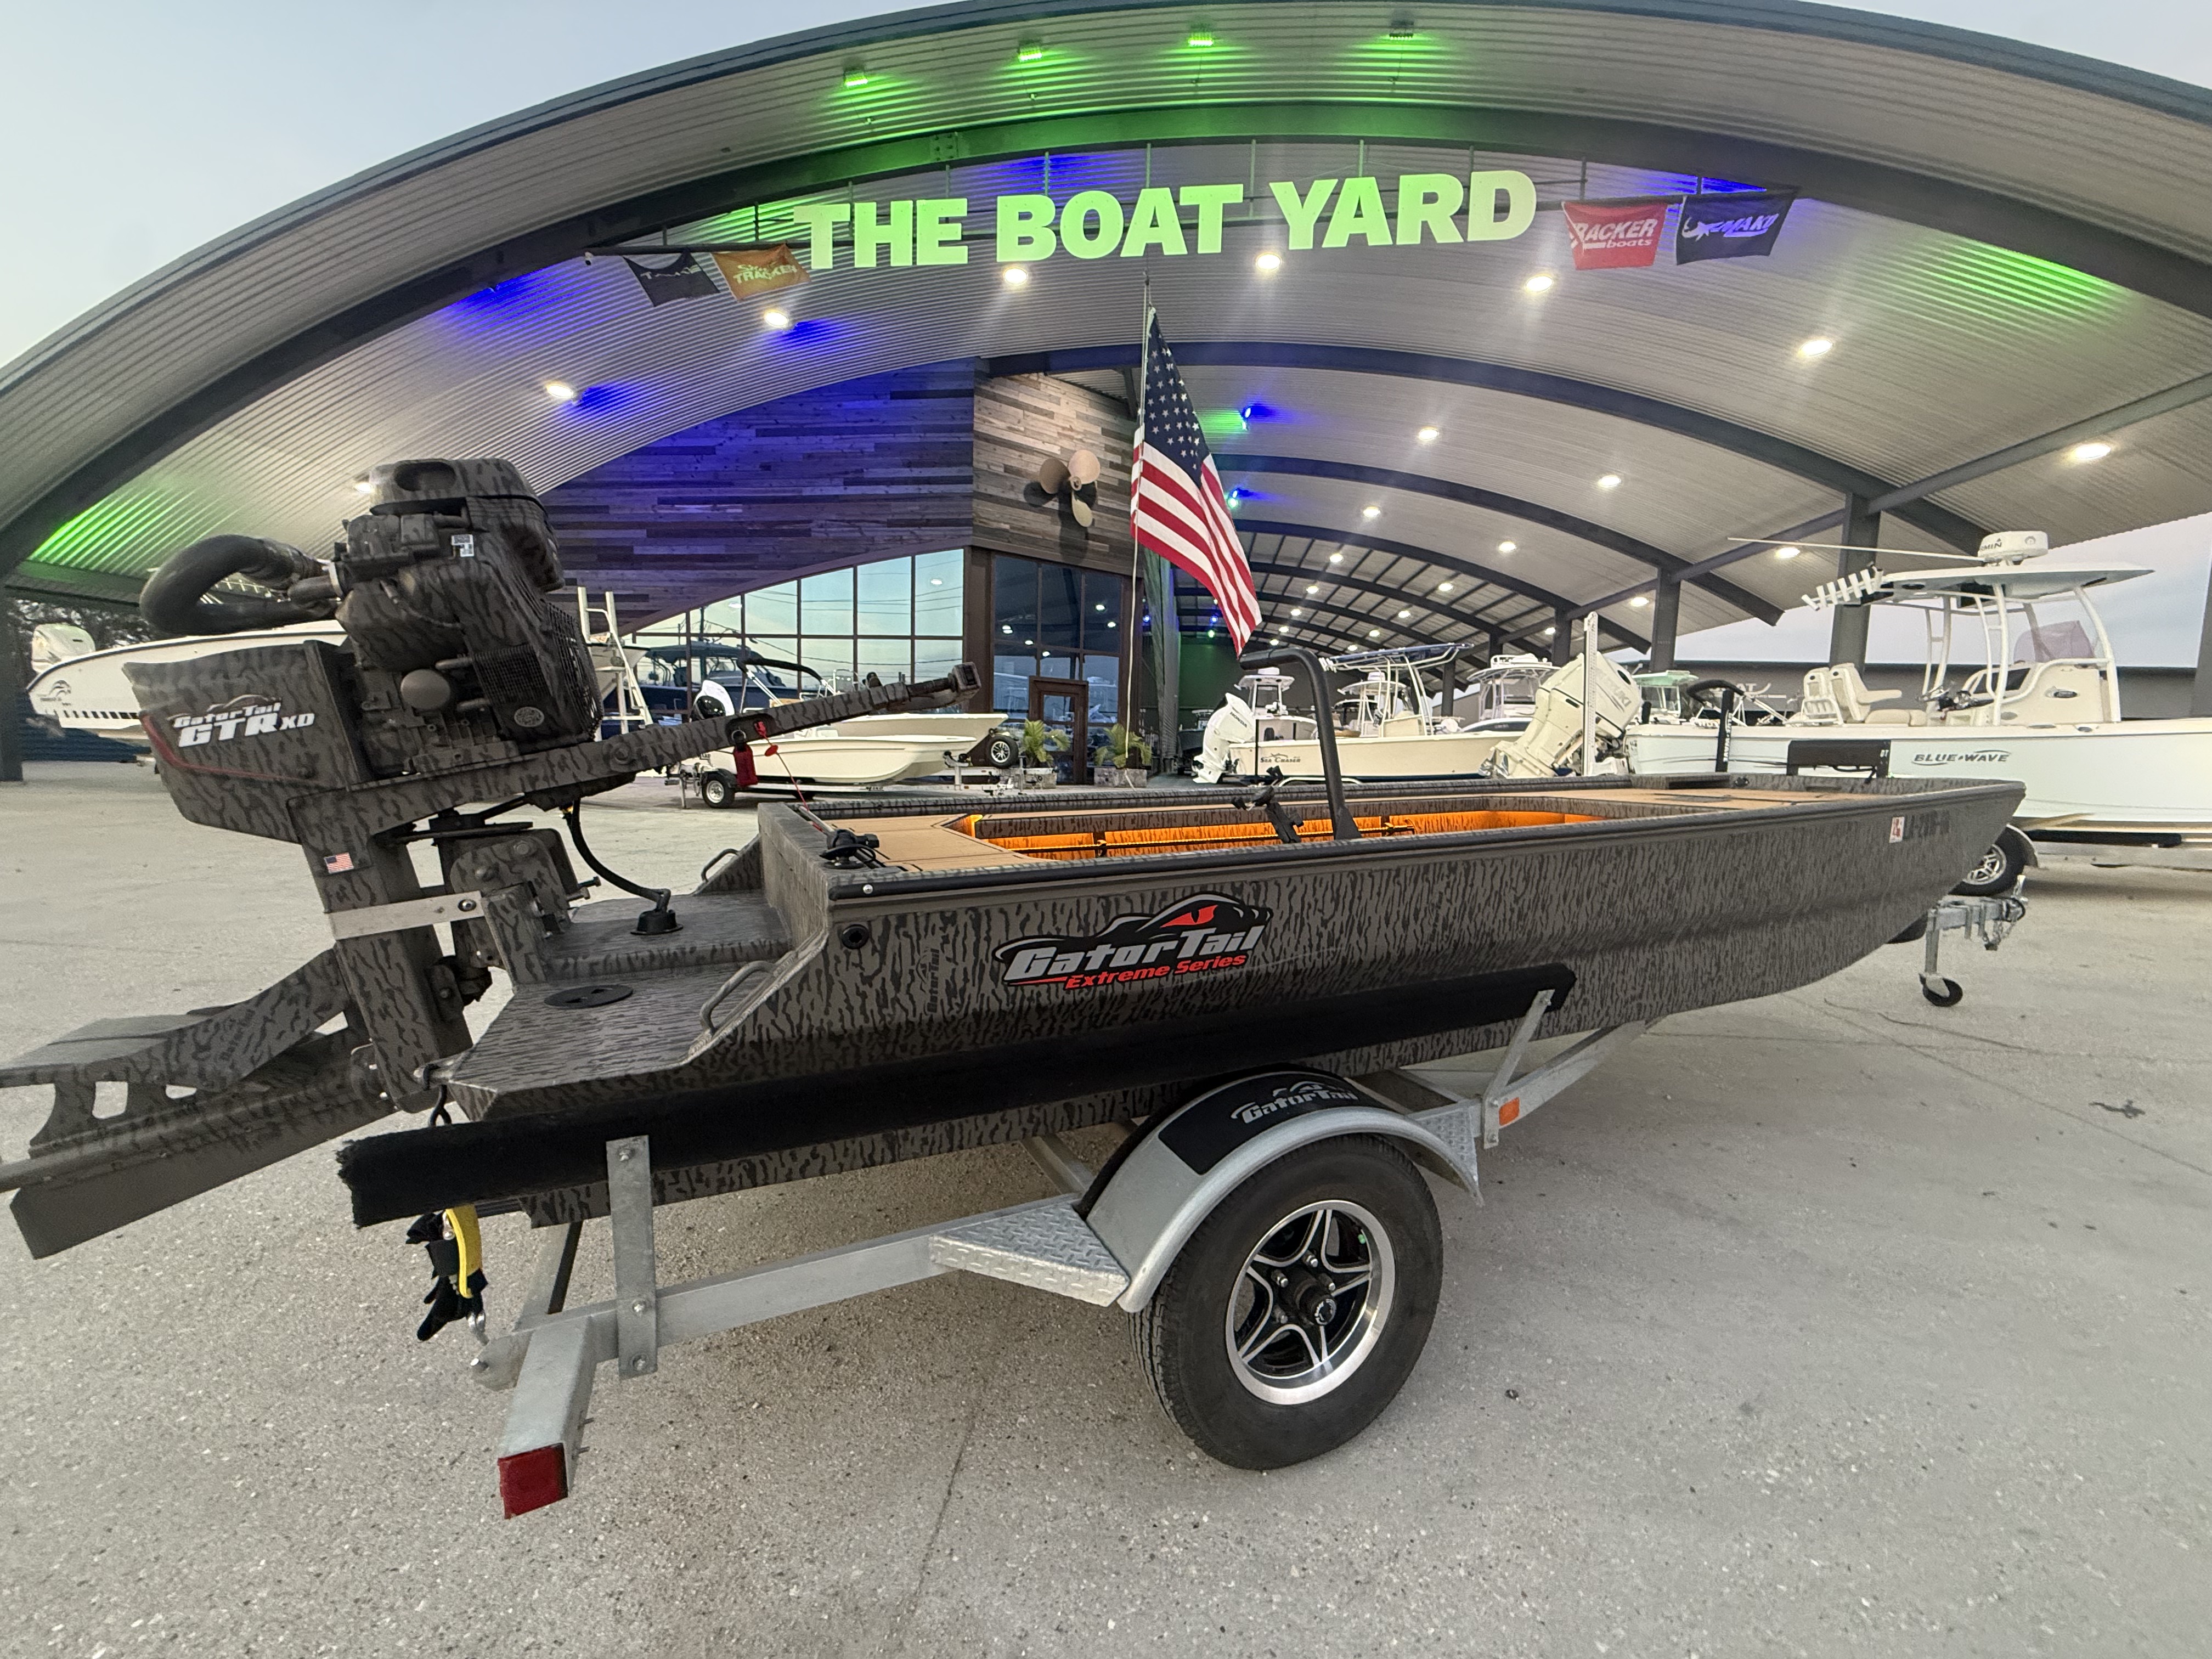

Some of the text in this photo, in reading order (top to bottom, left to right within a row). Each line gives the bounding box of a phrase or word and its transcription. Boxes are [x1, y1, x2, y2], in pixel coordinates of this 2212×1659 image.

[794, 170, 1537, 269] THE BOAT YARD
[1571, 218, 1658, 242] RACKER
[1722, 213, 1779, 236] MAKO
[1606, 239, 1653, 249] boats
[178, 712, 278, 747] GTR
[1003, 925, 1265, 981] GatorTail
[1064, 953, 1247, 990] Extreme Series
